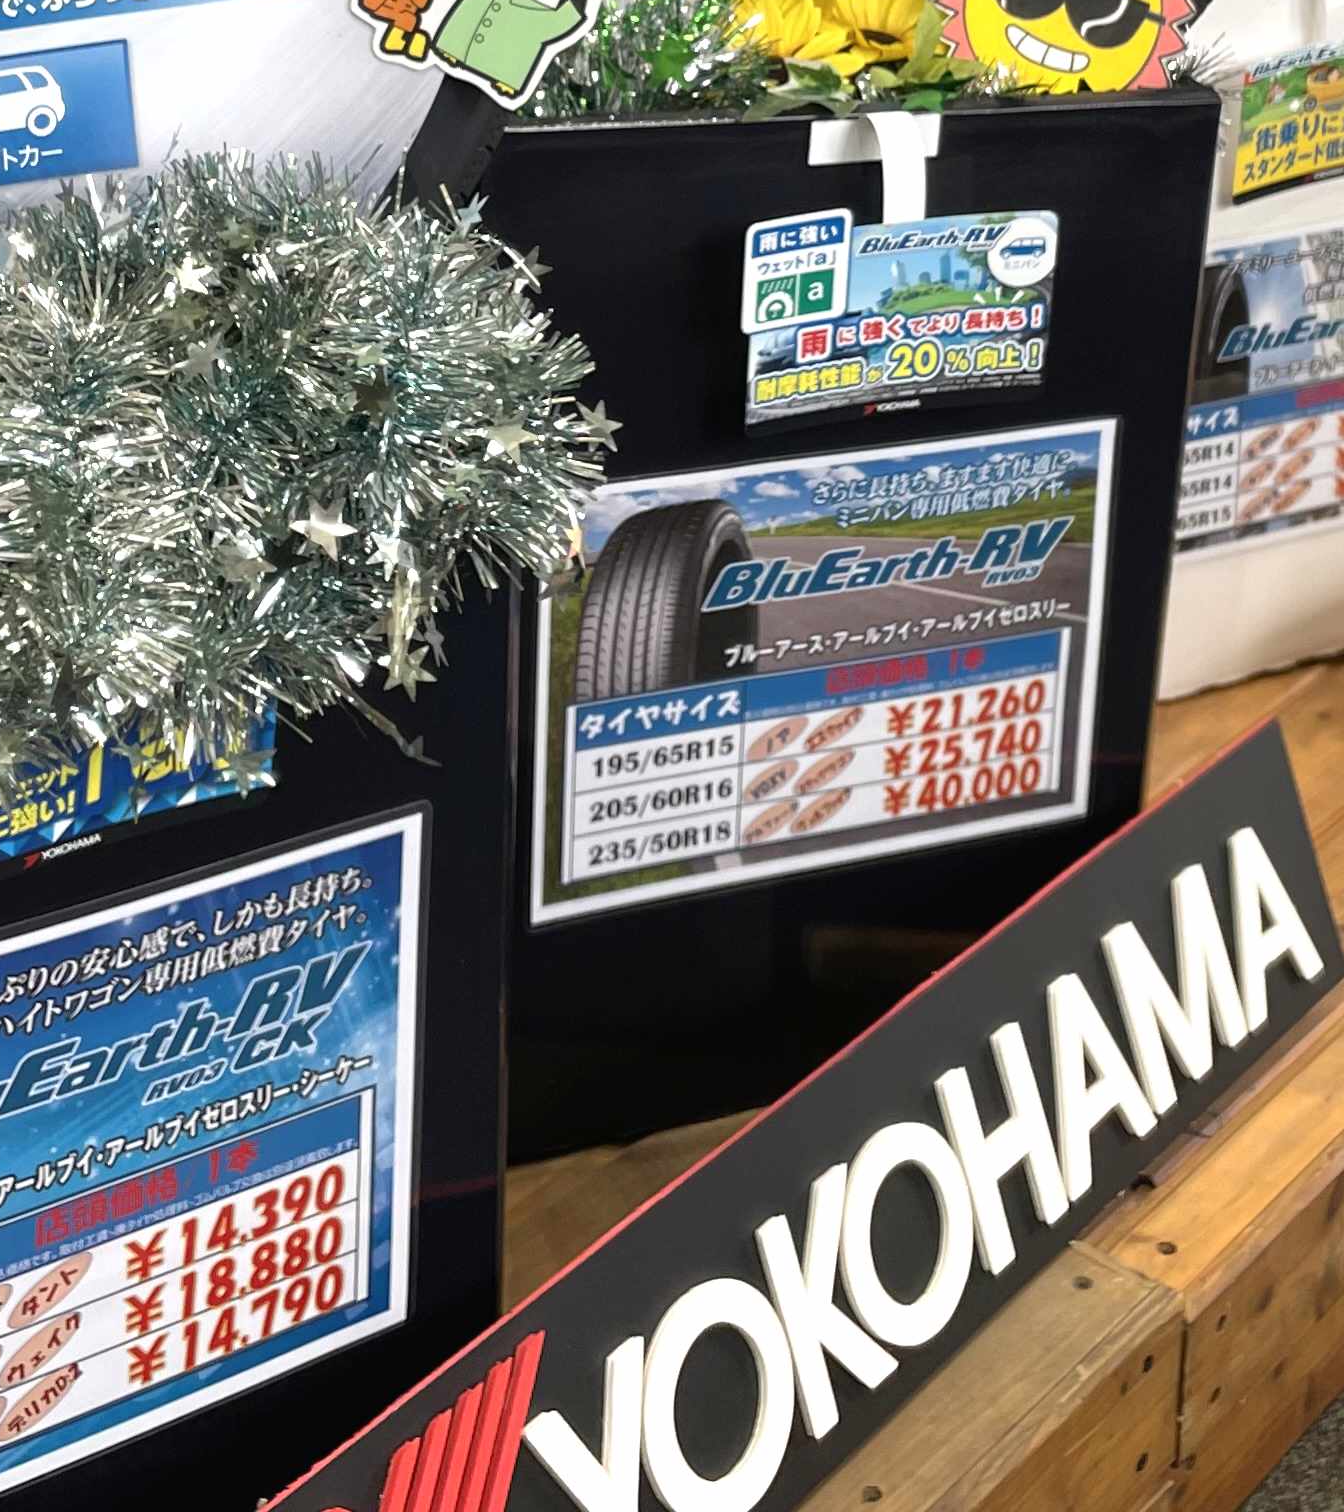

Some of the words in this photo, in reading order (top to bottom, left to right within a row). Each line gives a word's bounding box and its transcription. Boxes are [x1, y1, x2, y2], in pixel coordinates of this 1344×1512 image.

[759, 224, 839, 253] 雨に強い
[858, 225, 1006, 254] BluEarth-RV
[702, 516, 1076, 613] BluEarth-RV
[982, 565, 1042, 589] RV03
[578, 689, 741, 740] タイヤサイズ
[593, 736, 734, 779] 195/65R15
[589, 782, 733, 824] 205/60R16
[40, 833, 102, 861] YOKOHAMA
[588, 822, 732, 867] 235/50R18
[231, 1009, 331, 1075] CK
[523, 826, 1325, 1512] YOKOHAMA
